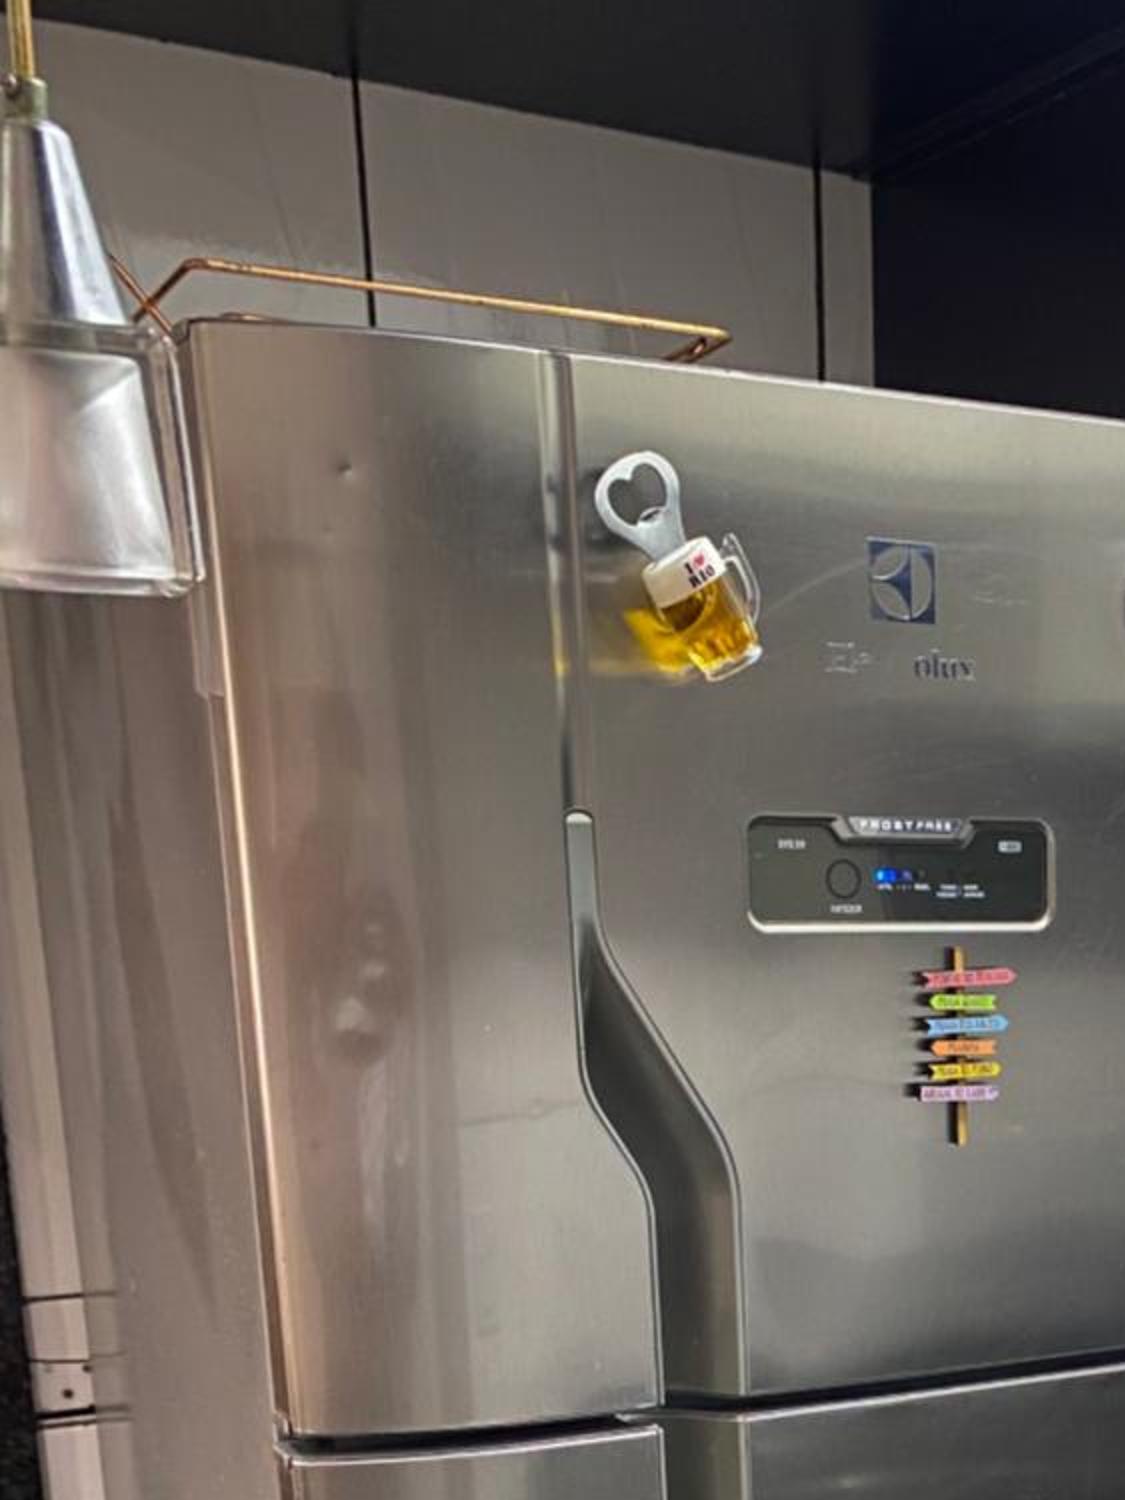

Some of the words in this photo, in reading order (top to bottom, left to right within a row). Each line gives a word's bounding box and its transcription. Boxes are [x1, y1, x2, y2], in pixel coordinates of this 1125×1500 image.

[688, 564, 717, 588] RIO
[859, 819, 913, 832] FROST
[915, 819, 952, 832] FREE
